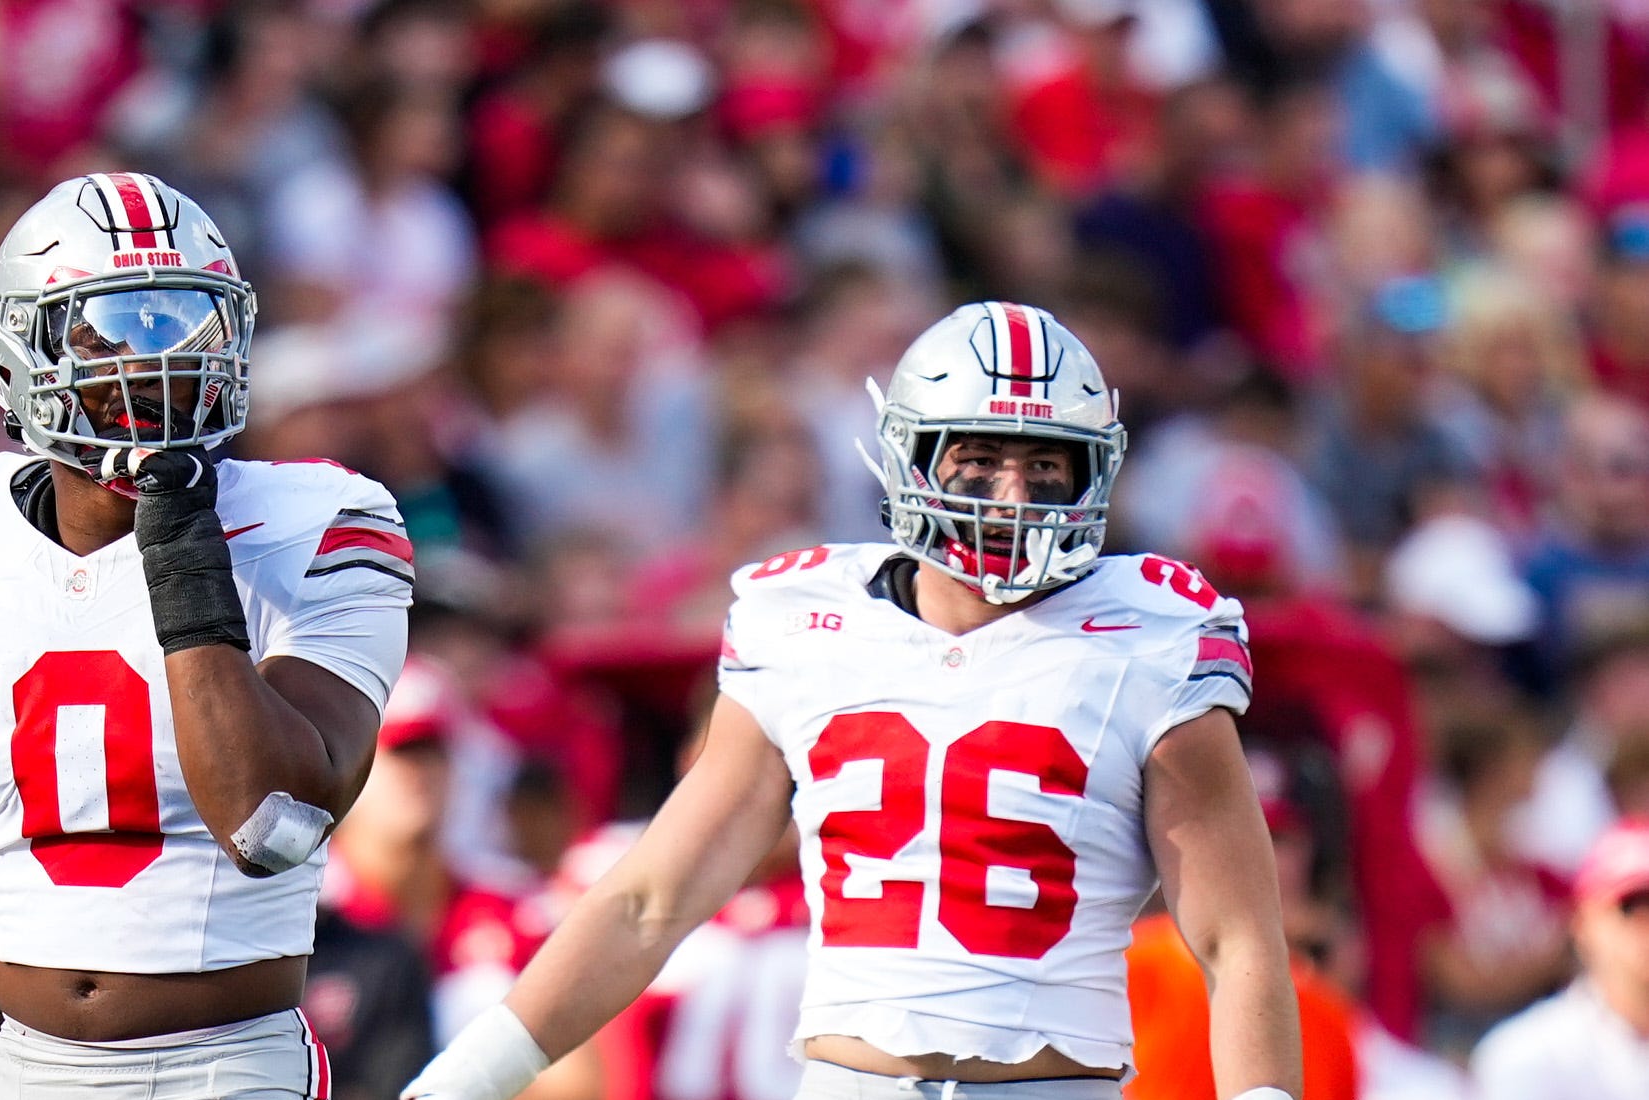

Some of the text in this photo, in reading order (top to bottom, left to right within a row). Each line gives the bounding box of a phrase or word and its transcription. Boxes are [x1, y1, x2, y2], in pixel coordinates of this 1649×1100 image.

[113, 252, 182, 268] OHIO STATE
[990, 401, 1053, 419] OHIO STATE
[11, 650, 166, 888] 0
[808, 711, 1089, 960] 26
